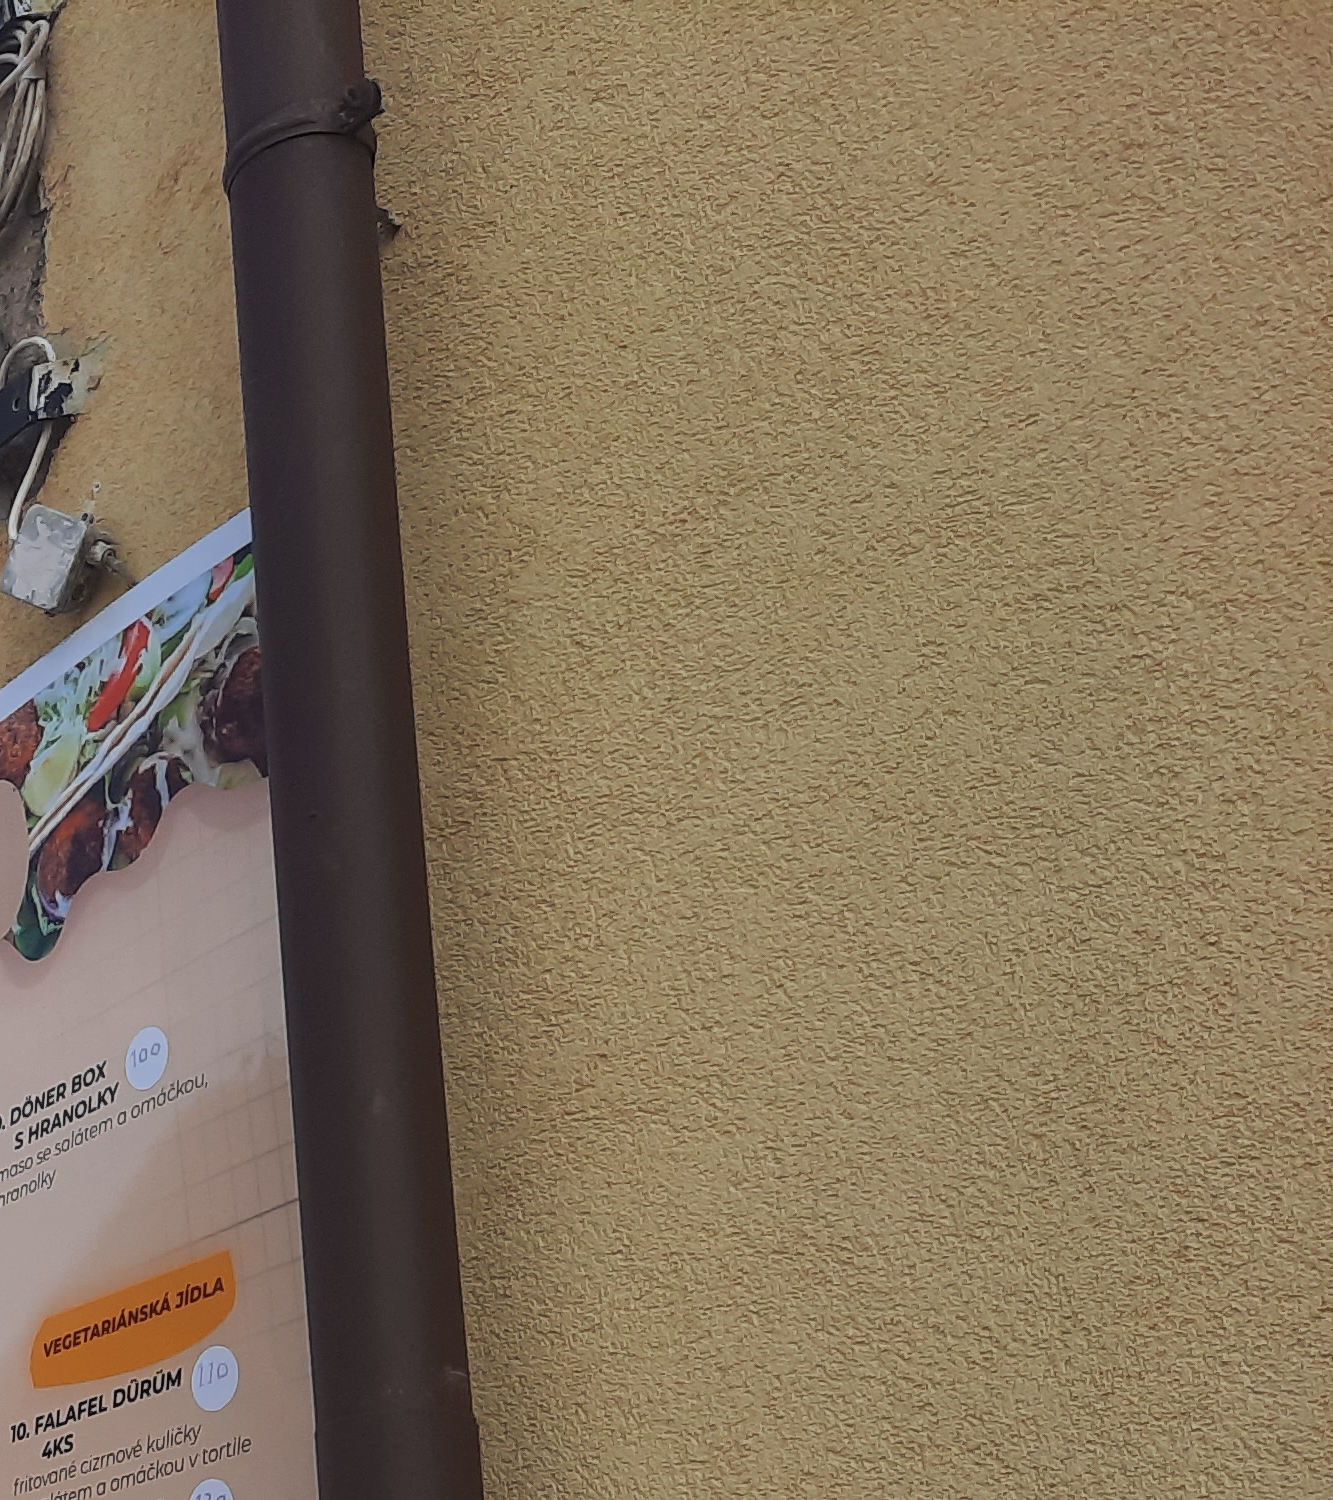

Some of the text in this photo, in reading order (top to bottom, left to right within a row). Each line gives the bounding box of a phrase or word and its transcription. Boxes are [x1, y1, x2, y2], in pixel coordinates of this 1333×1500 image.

[131, 1043, 160, 1067] 100
[10, 1083, 66, 1125] DÖNER
[72, 1060, 107, 1095] BOX
[14, 1082, 119, 1150] S HRANOLKY
[36, 1147, 51, 1165] se
[55, 1117, 113, 1156] salátem
[117, 1111, 126, 1125] a
[131, 1073, 208, 1119] omáčkou,
[43, 1277, 224, 1358] VEGETARIÁNSKÁ JÍDLA
[11, 1368, 182, 1443] 10. FALAFEL DÜRÜM
[14, 1424, 202, 1496] fritované cizrnové kuličky
[42, 1434, 74, 1459] 4KS
[96, 1482, 106, 1497] a
[110, 1458, 184, 1492] omáčkou
[201, 1437, 252, 1466] tortile
